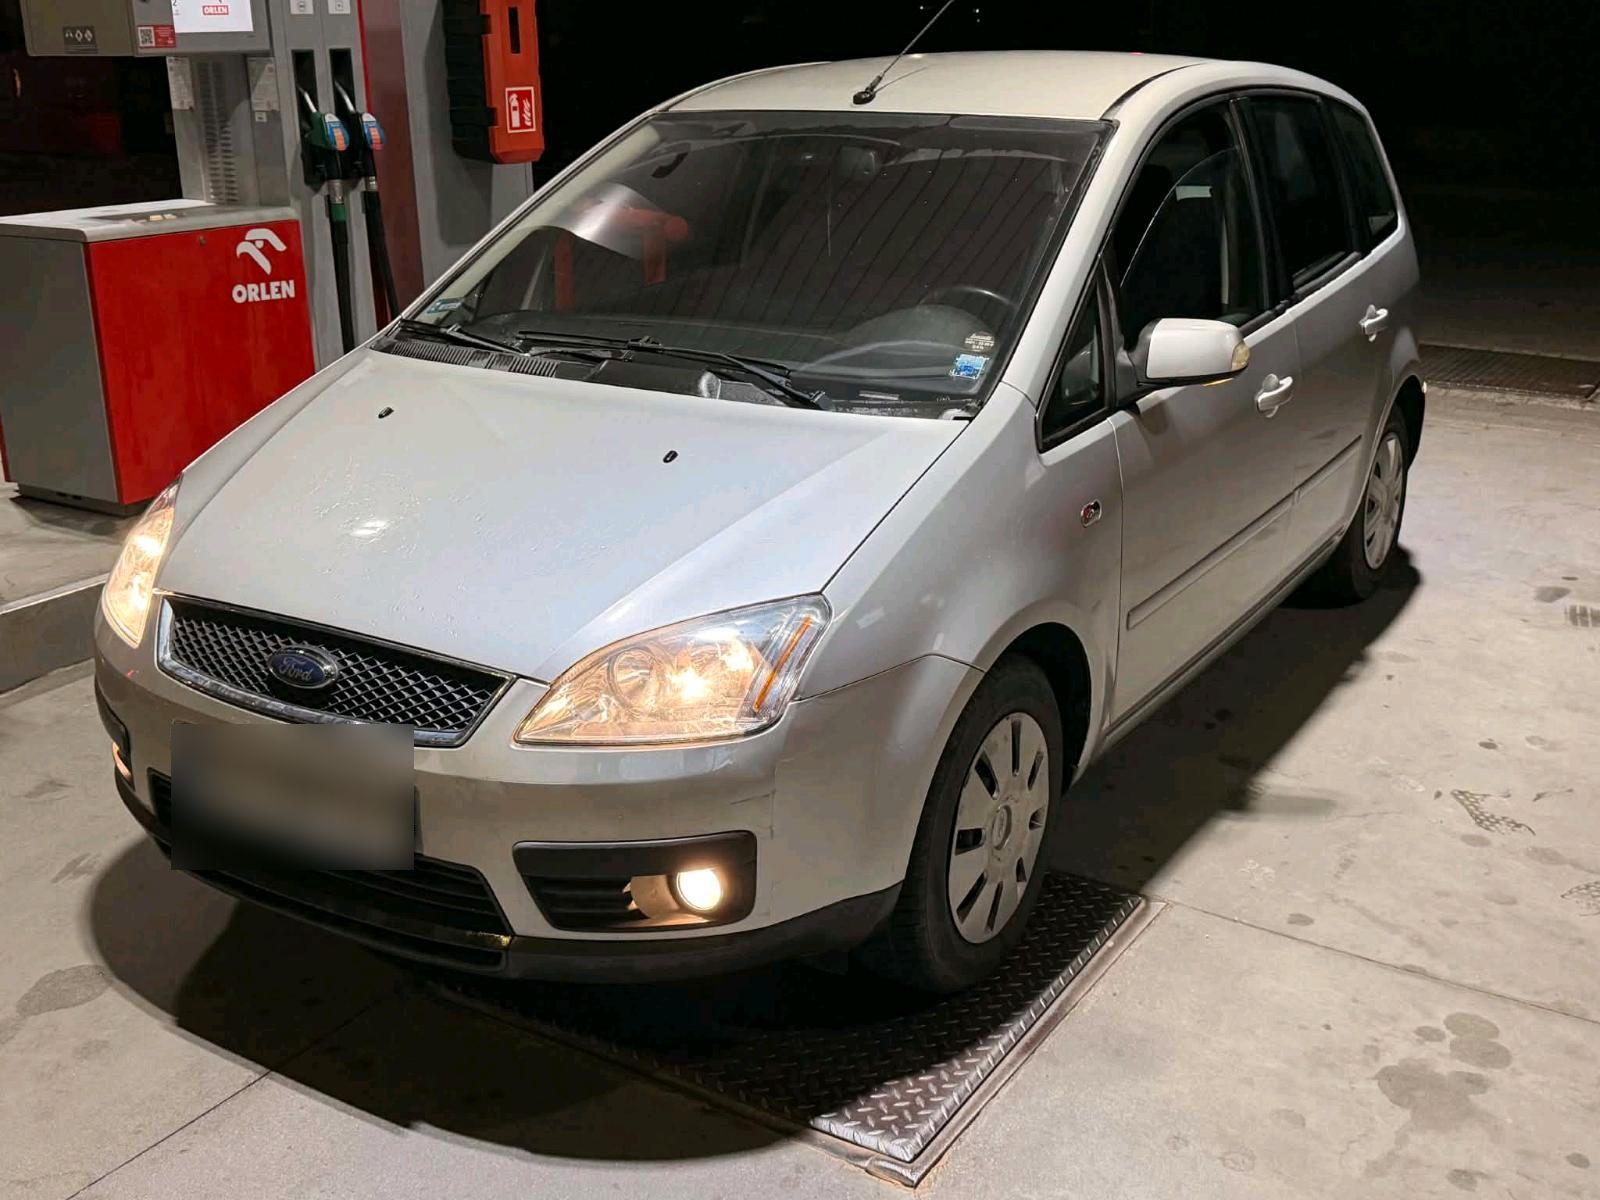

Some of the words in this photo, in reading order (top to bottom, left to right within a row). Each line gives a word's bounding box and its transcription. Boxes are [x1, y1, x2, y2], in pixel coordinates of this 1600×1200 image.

[204, 6, 228, 14] ORLEN
[232, 280, 295, 303] ORLEN
[278, 656, 313, 681] Ford
